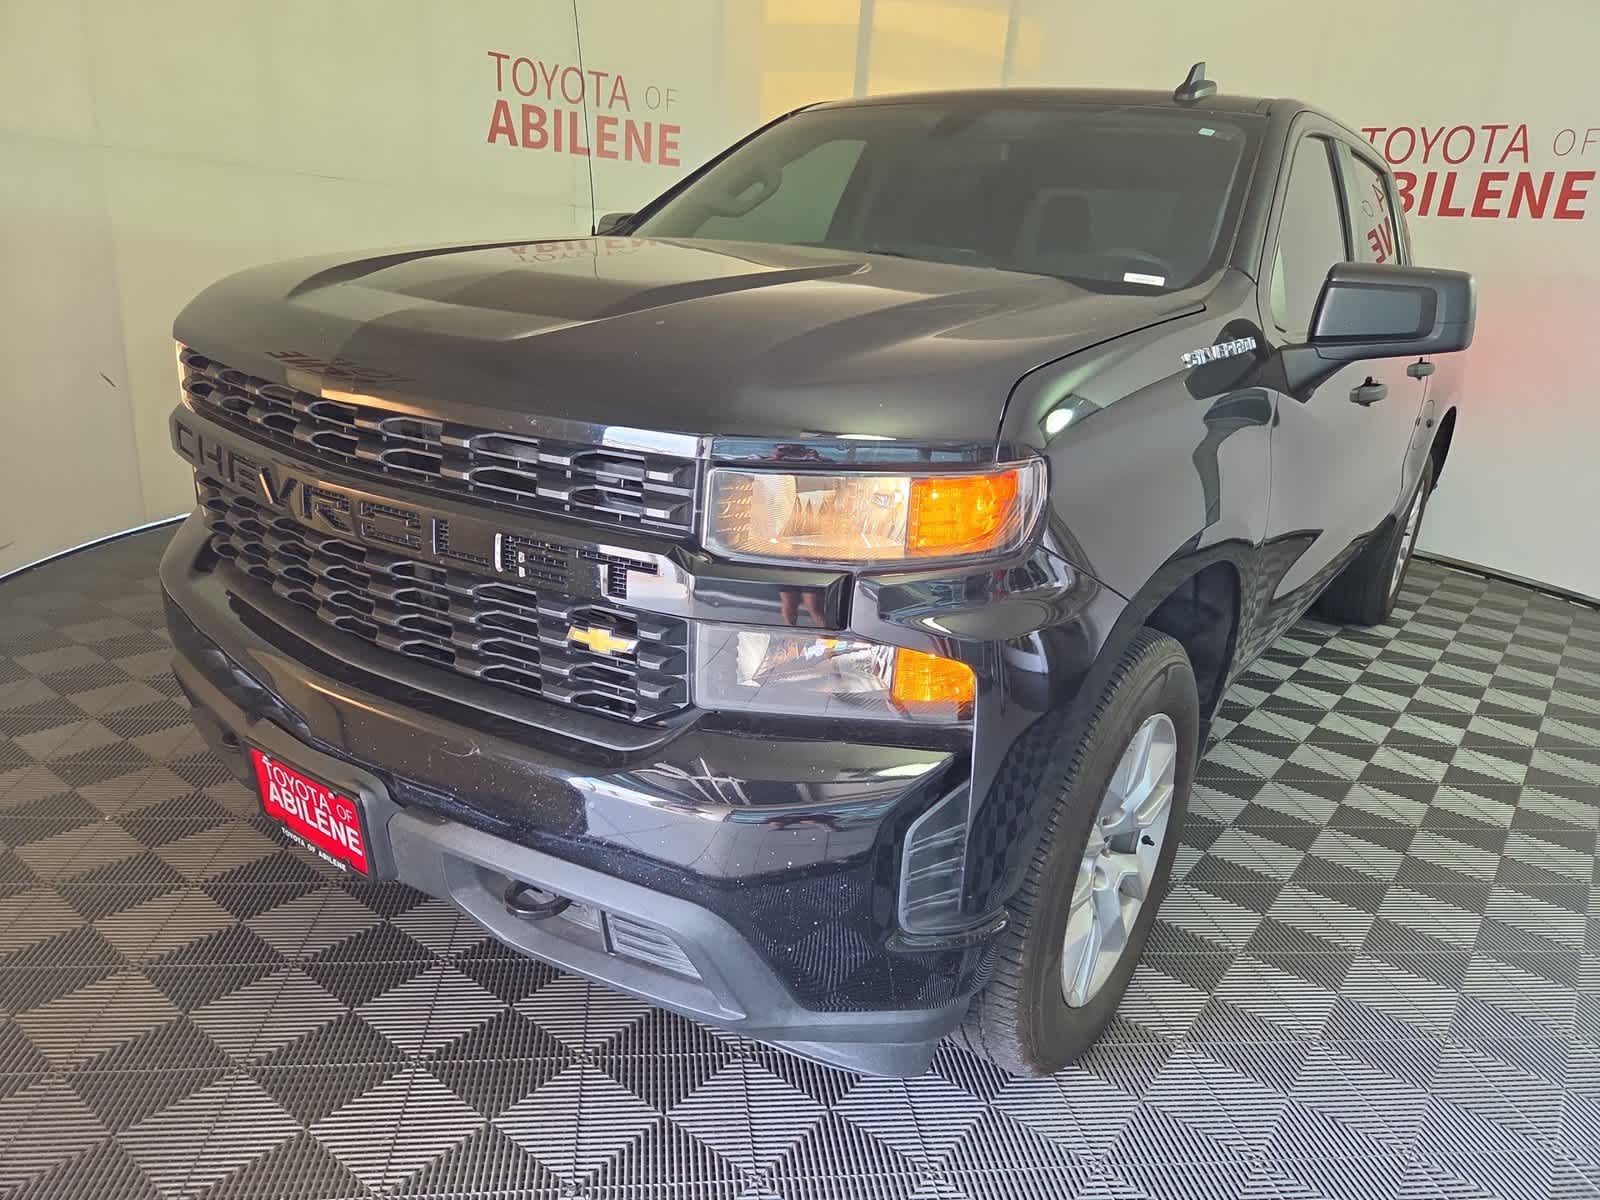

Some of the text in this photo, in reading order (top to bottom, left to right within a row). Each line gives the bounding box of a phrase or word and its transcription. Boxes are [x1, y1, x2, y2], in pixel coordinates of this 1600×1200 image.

[488, 51, 679, 112] TOYOTA OF
[487, 99, 681, 167] ABILENE
[1553, 128, 1600, 156] OF
[1393, 171, 1596, 220] BILENE
[175, 419, 662, 600] CHEVROLET
[262, 757, 352, 822] TOYOTA OF
[269, 781, 362, 856] ABILENE
